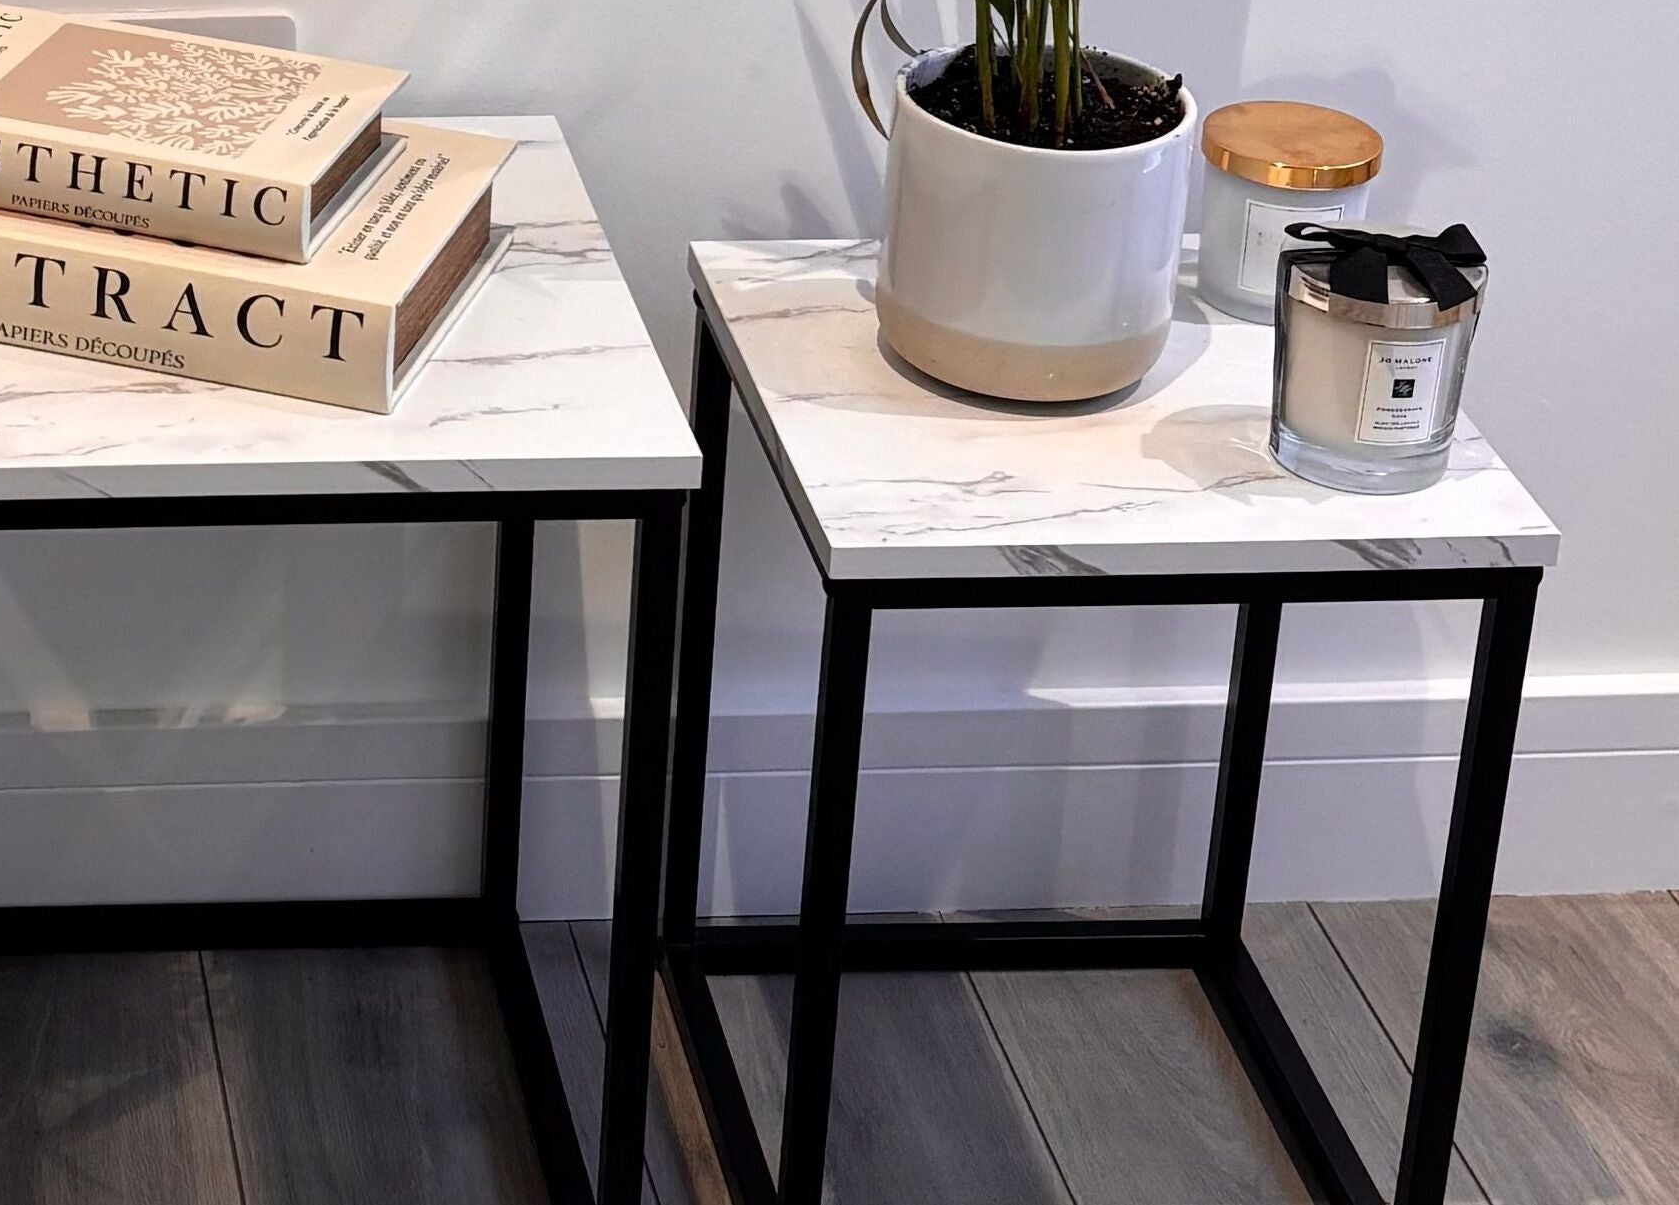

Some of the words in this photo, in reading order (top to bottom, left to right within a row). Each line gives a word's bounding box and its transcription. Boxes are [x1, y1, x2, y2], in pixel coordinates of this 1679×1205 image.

[11, 193, 71, 215] PAPIERS
[73, 204, 151, 230] DÉCOUPÉS
[74, 335, 186, 370] DÉCOUPÉS
